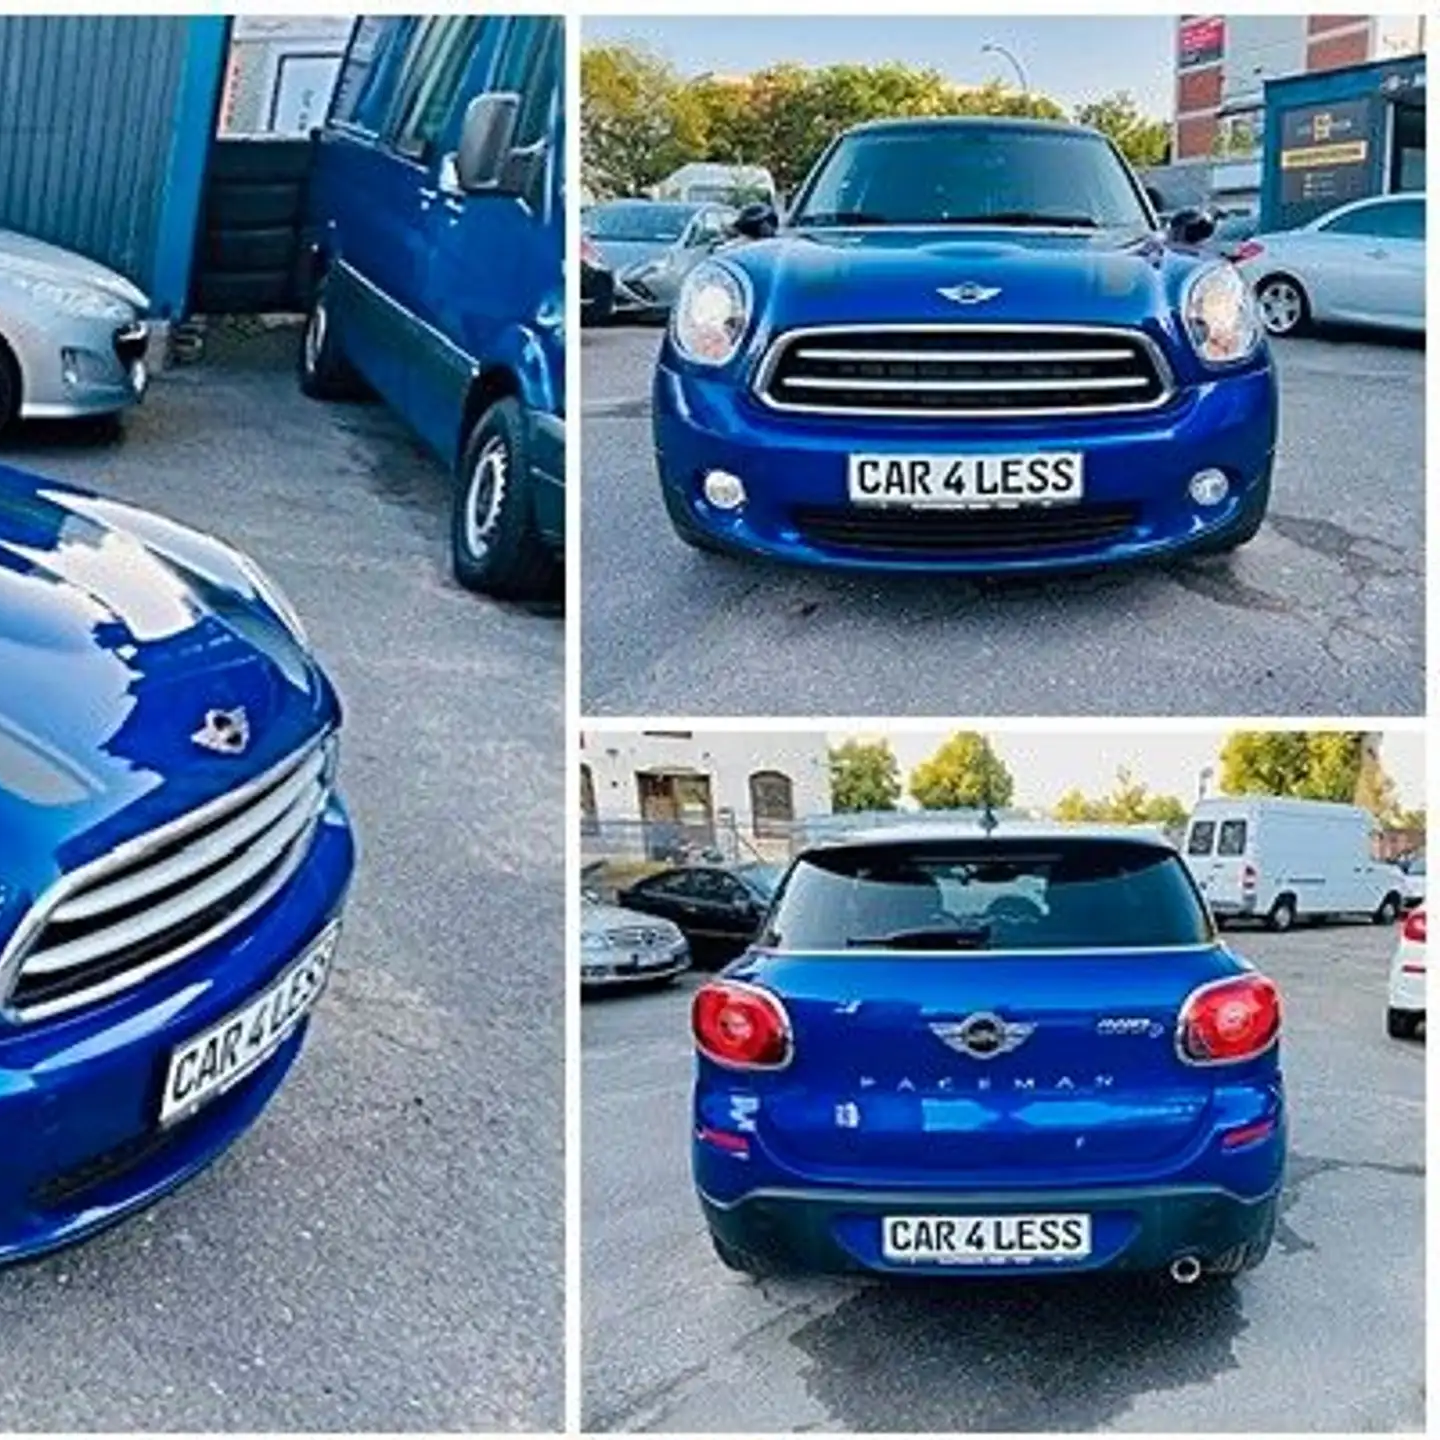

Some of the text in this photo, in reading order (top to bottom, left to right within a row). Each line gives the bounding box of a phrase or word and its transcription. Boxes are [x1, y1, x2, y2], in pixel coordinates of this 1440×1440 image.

[858, 457, 1074, 495] CAR 4 LESS
[173, 1021, 243, 1101] CAR
[246, 1002, 269, 1047] 4
[891, 1219, 1082, 1251] CAR 4 LESS
